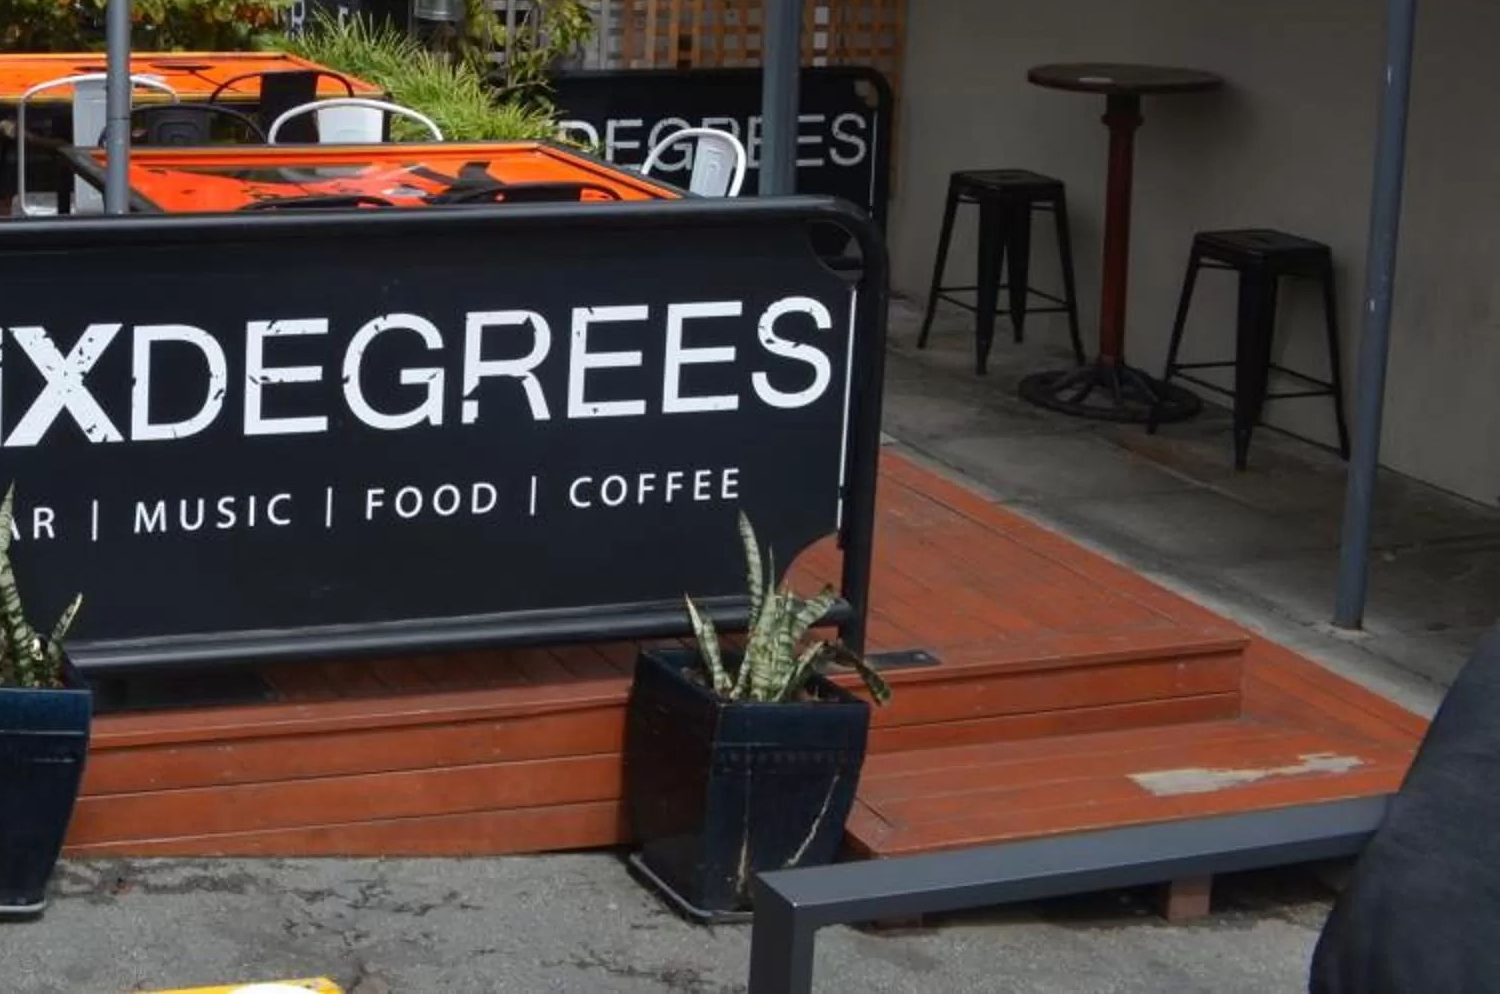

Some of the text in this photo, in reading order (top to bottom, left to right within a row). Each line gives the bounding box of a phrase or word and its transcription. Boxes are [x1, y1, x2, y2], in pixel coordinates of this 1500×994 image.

[134, 493, 292, 533] MUSIC
[366, 482, 498, 520] FOOD
[569, 468, 739, 508] COFFEE
